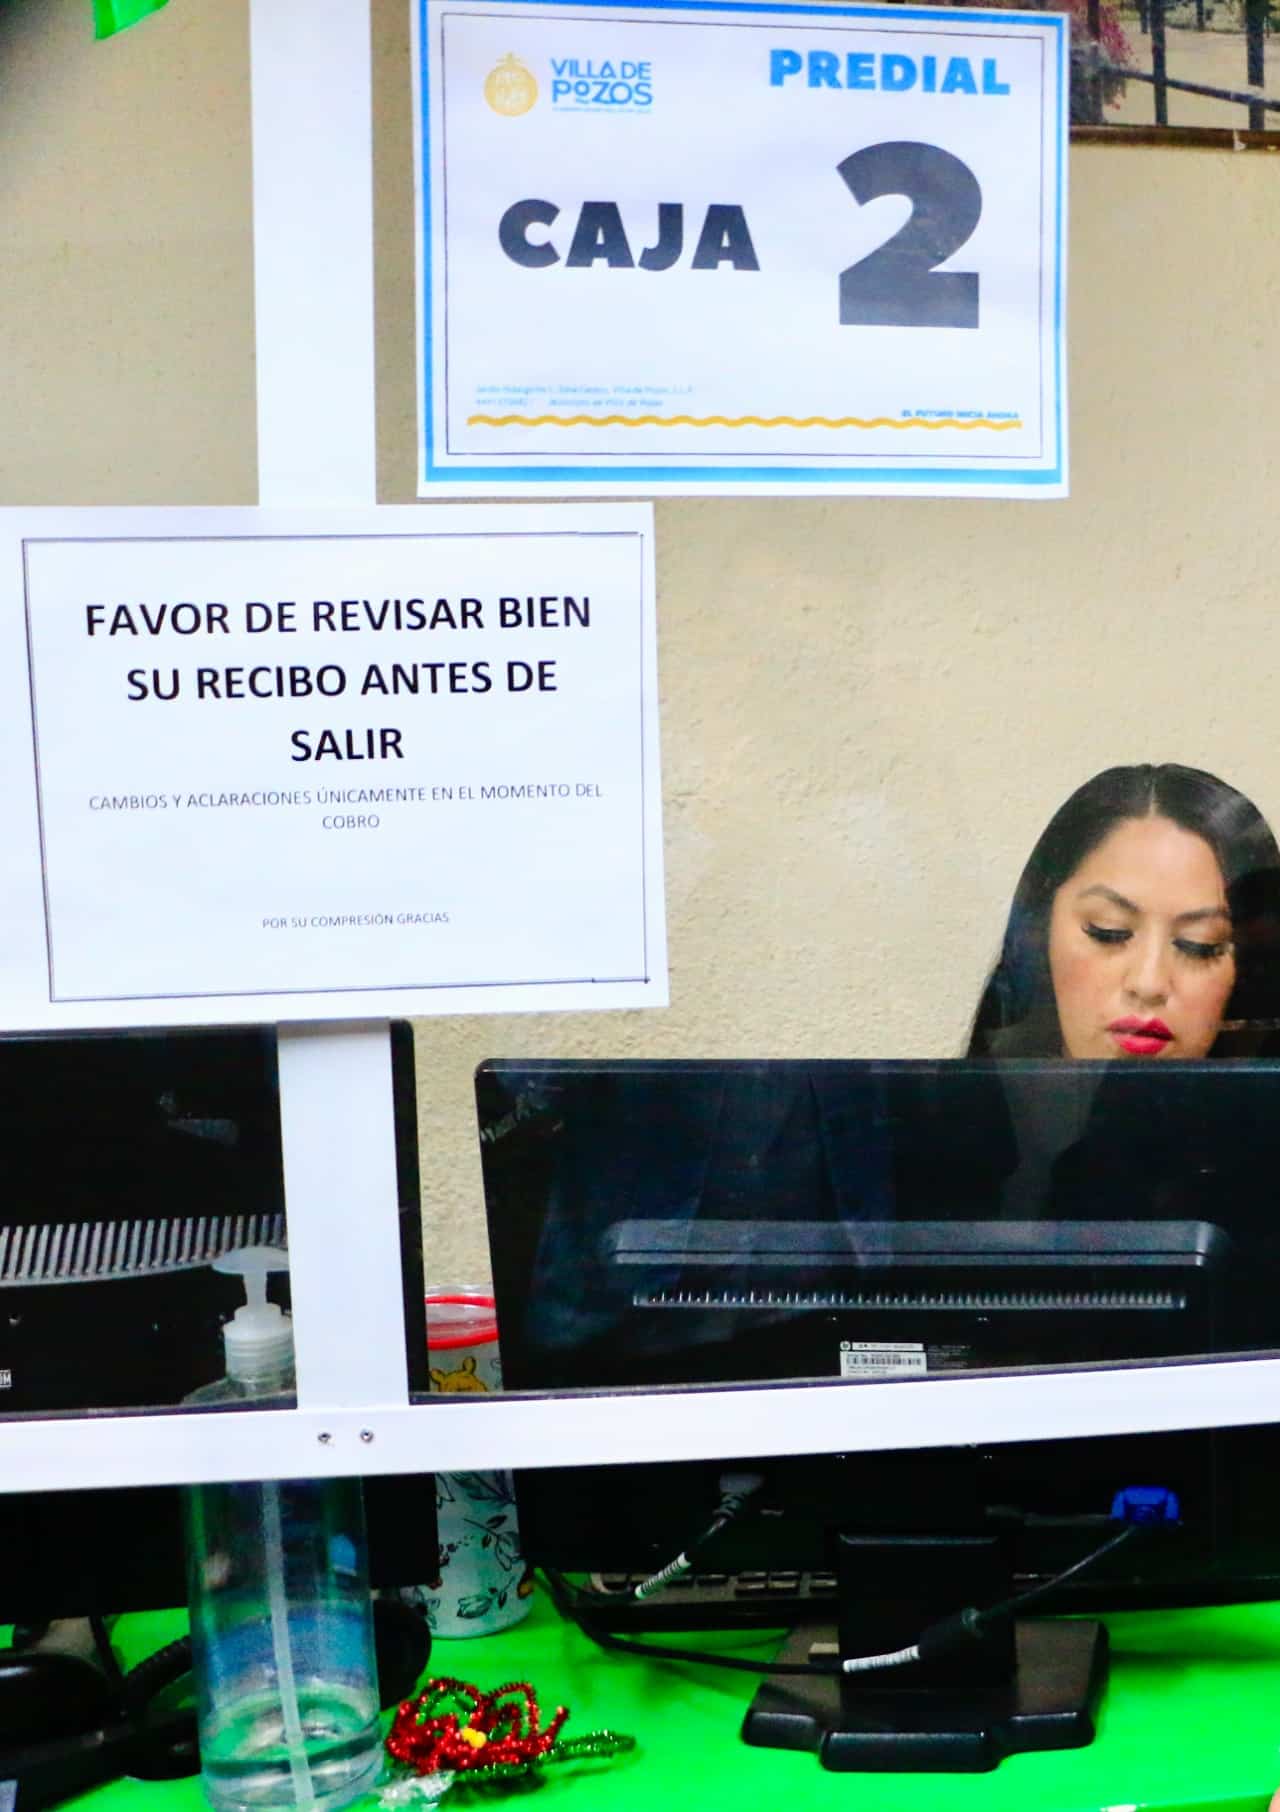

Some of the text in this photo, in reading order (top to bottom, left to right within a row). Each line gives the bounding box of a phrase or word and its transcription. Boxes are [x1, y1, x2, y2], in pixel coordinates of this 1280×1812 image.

[551, 58, 652, 81] VILLA DE
[770, 49, 1010, 95] PREDIAL
[498, 198, 761, 271] CAJA
[836, 140, 983, 328] 2
[86, 596, 590, 636] FAVOR DE REVISAR BIEN
[128, 660, 558, 701] SU RECIBO ANTES DE
[291, 727, 405, 762] SALIR
[89, 783, 603, 811] CAMBIOS Y ACLARACIONES ÚNICAMENTE EN EL MOMENTO DEL
[322, 814, 381, 830] COBRO
[262, 917, 288, 929] POR
[292, 917, 308, 928] SU
[396, 911, 450, 925] GRACIAS
